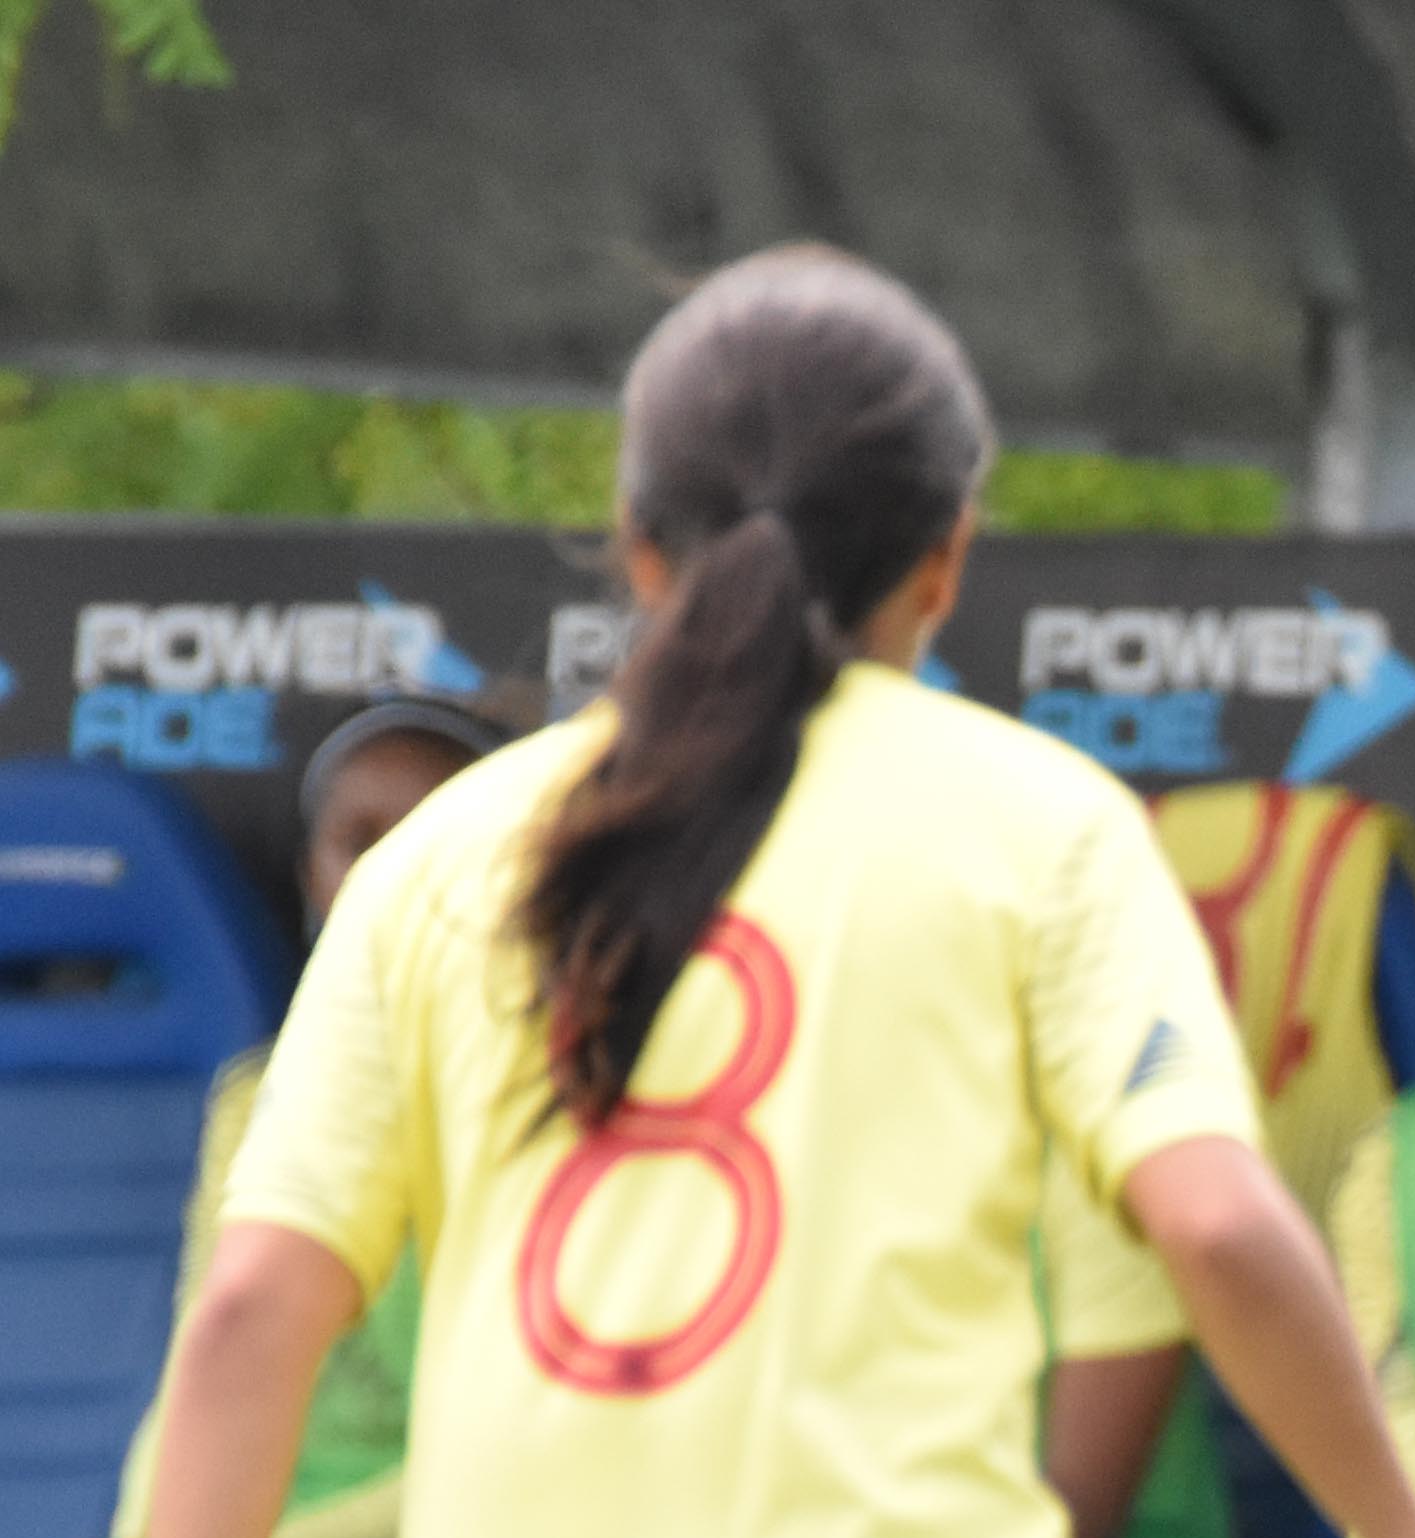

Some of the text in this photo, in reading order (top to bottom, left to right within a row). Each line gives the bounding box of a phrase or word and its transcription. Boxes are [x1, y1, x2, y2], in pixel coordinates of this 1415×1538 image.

[73, 602, 442, 695] POWER
[1020, 606, 1393, 698] POWER
[515, 906, 798, 1398] 8
